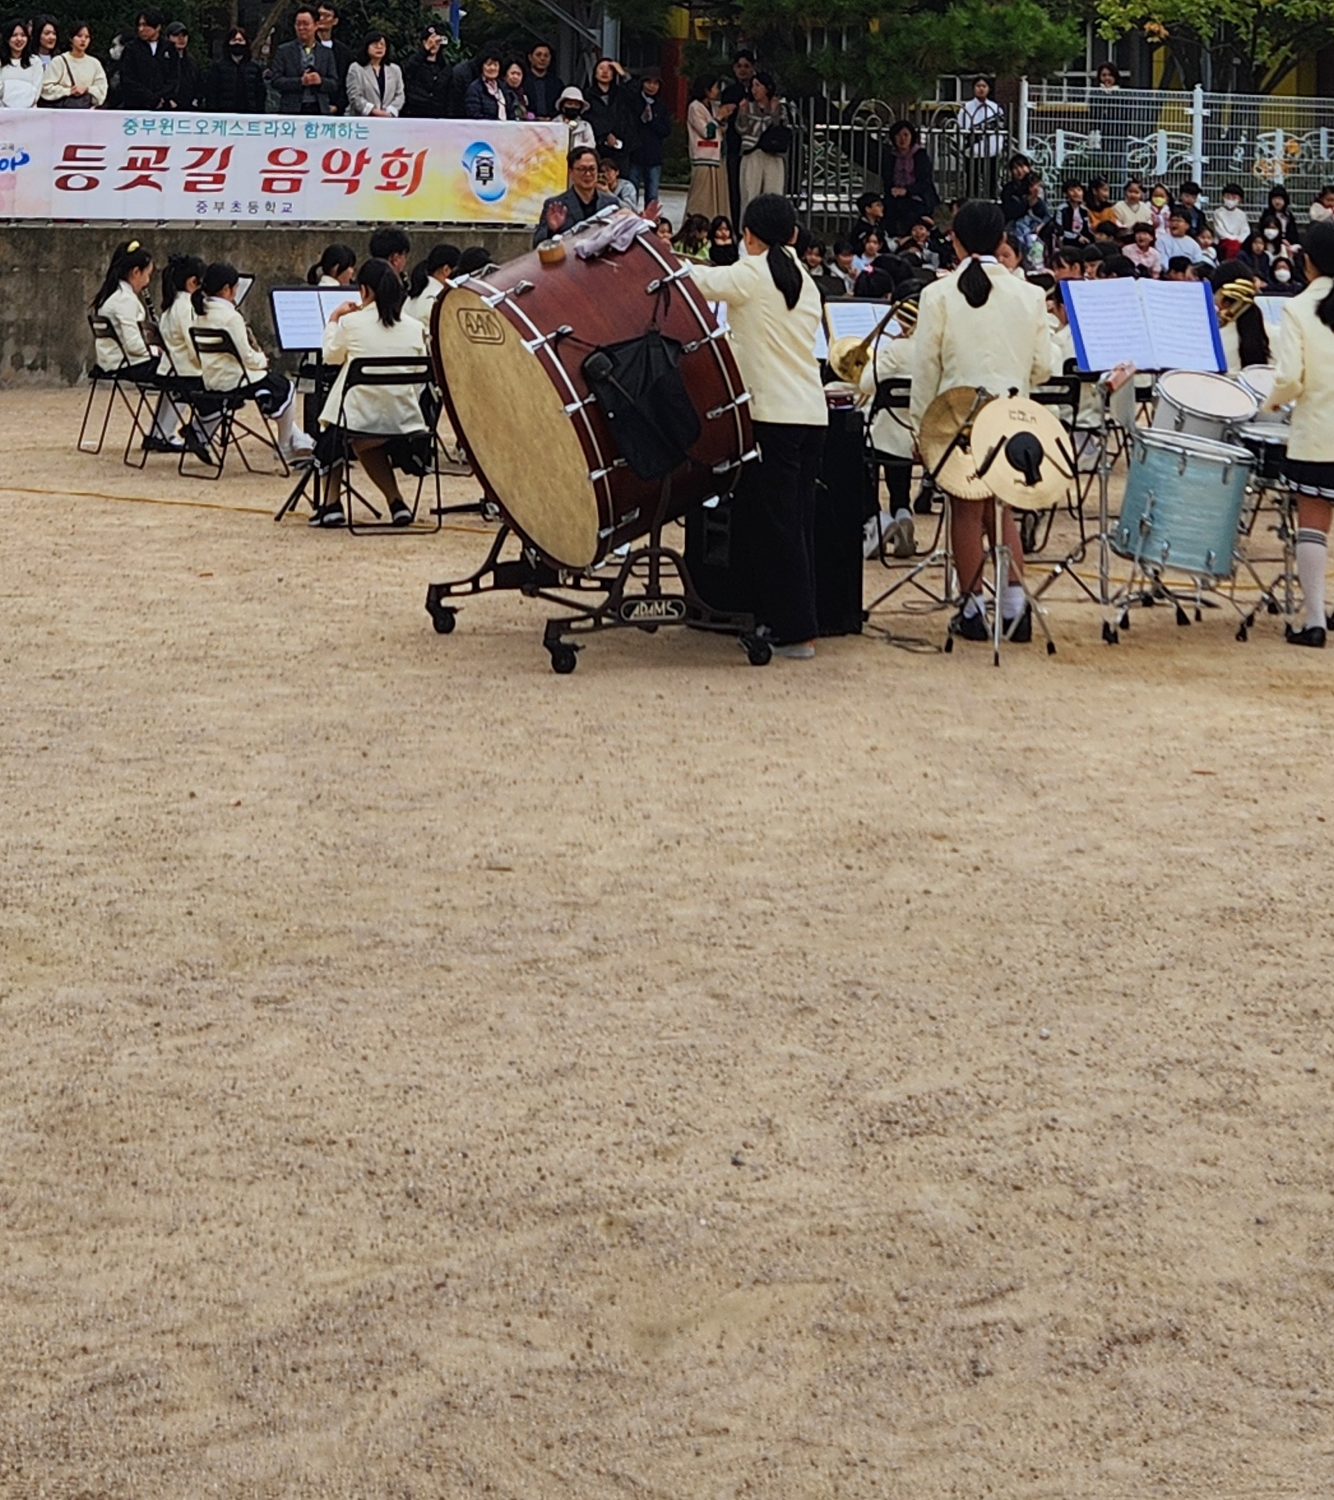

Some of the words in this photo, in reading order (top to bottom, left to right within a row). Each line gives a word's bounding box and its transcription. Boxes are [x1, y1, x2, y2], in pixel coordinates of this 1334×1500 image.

[304, 121, 370, 140] 함께하는
[53, 144, 235, 193] 등굣길
[258, 146, 430, 197] 음악회
[195, 199, 294, 215] 중부초등학교
[629, 600, 680, 620] ADAMS
